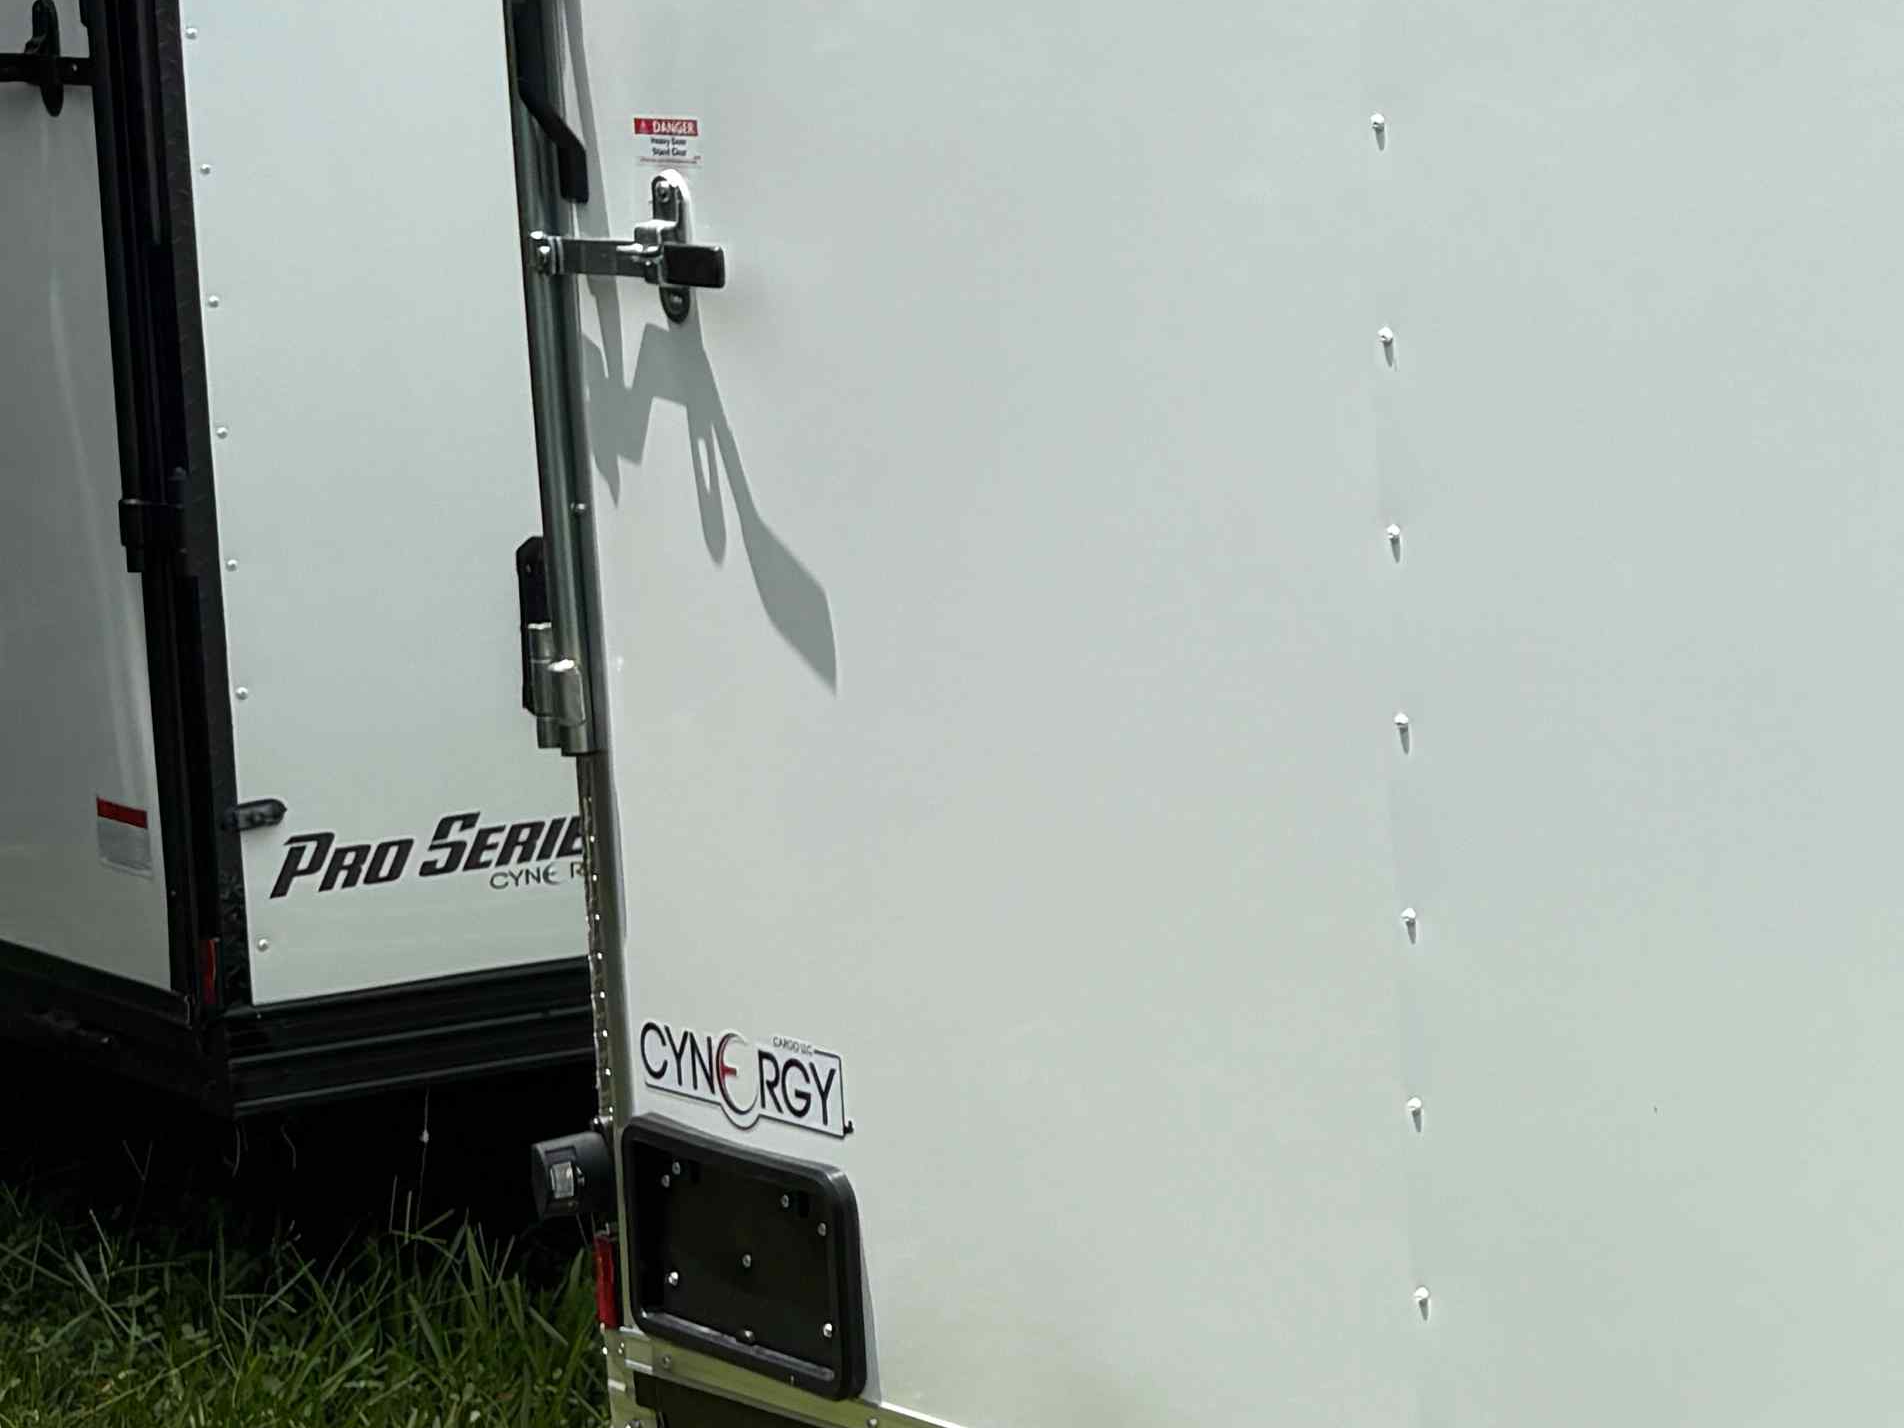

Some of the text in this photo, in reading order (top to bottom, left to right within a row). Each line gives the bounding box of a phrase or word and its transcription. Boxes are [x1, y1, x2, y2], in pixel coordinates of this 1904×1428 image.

[652, 119, 695, 135] DANGER
[772, 1035, 800, 1054] CARGO
[640, 1022, 836, 1127] CYNERGY
